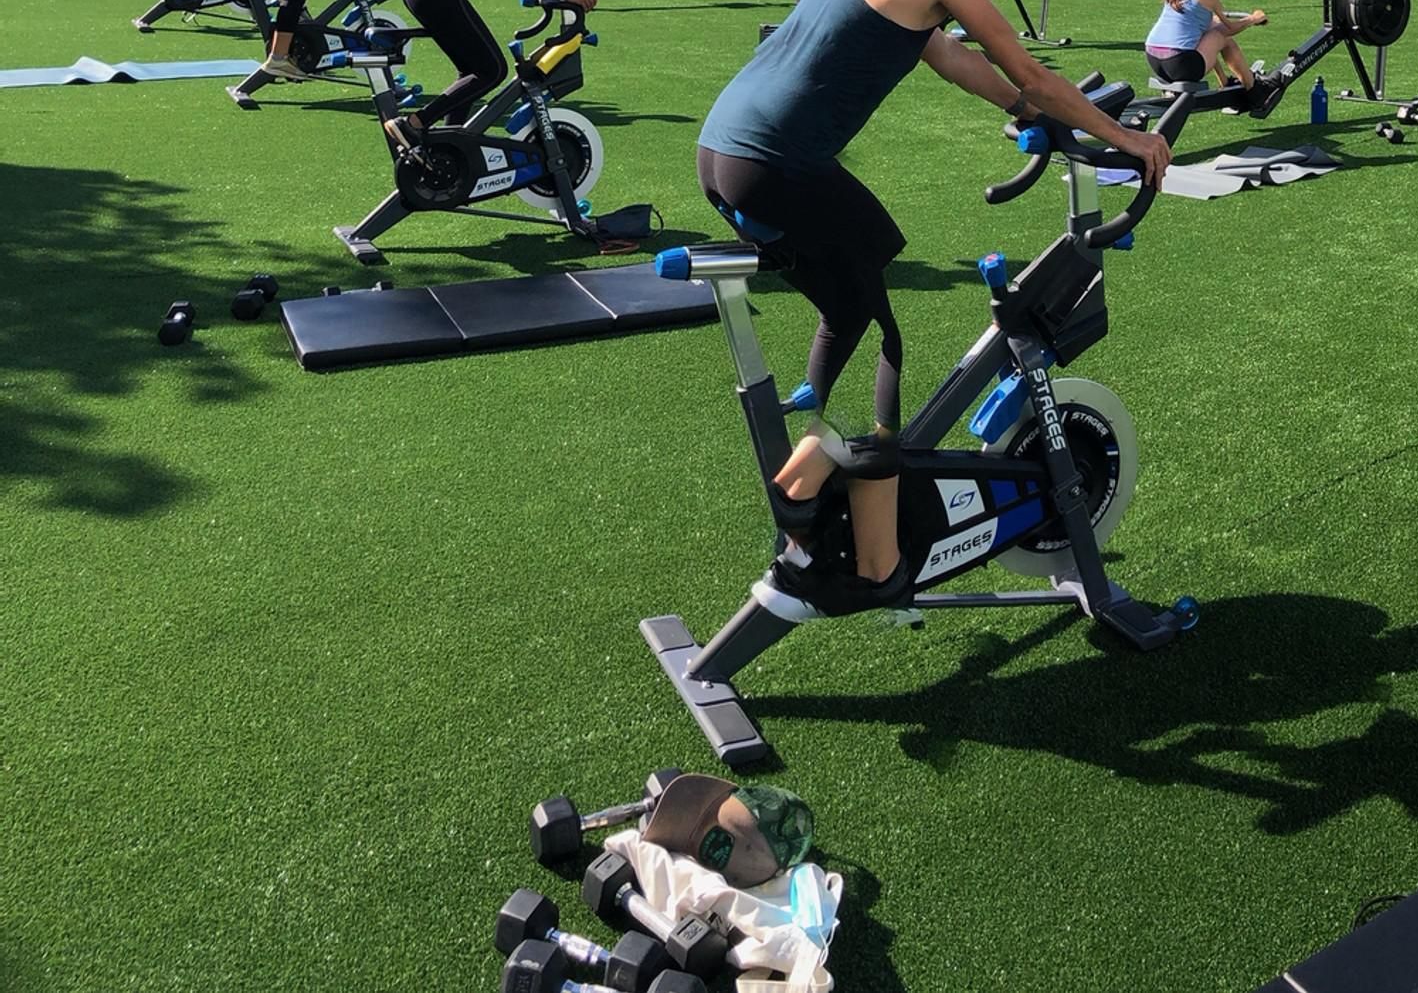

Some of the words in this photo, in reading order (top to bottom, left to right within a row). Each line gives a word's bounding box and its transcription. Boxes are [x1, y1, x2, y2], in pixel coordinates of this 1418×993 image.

[477, 175, 512, 190] STAGES
[1033, 368, 1066, 451] STAGES
[1071, 412, 1109, 435] STAGES
[930, 530, 992, 566] STAGES
